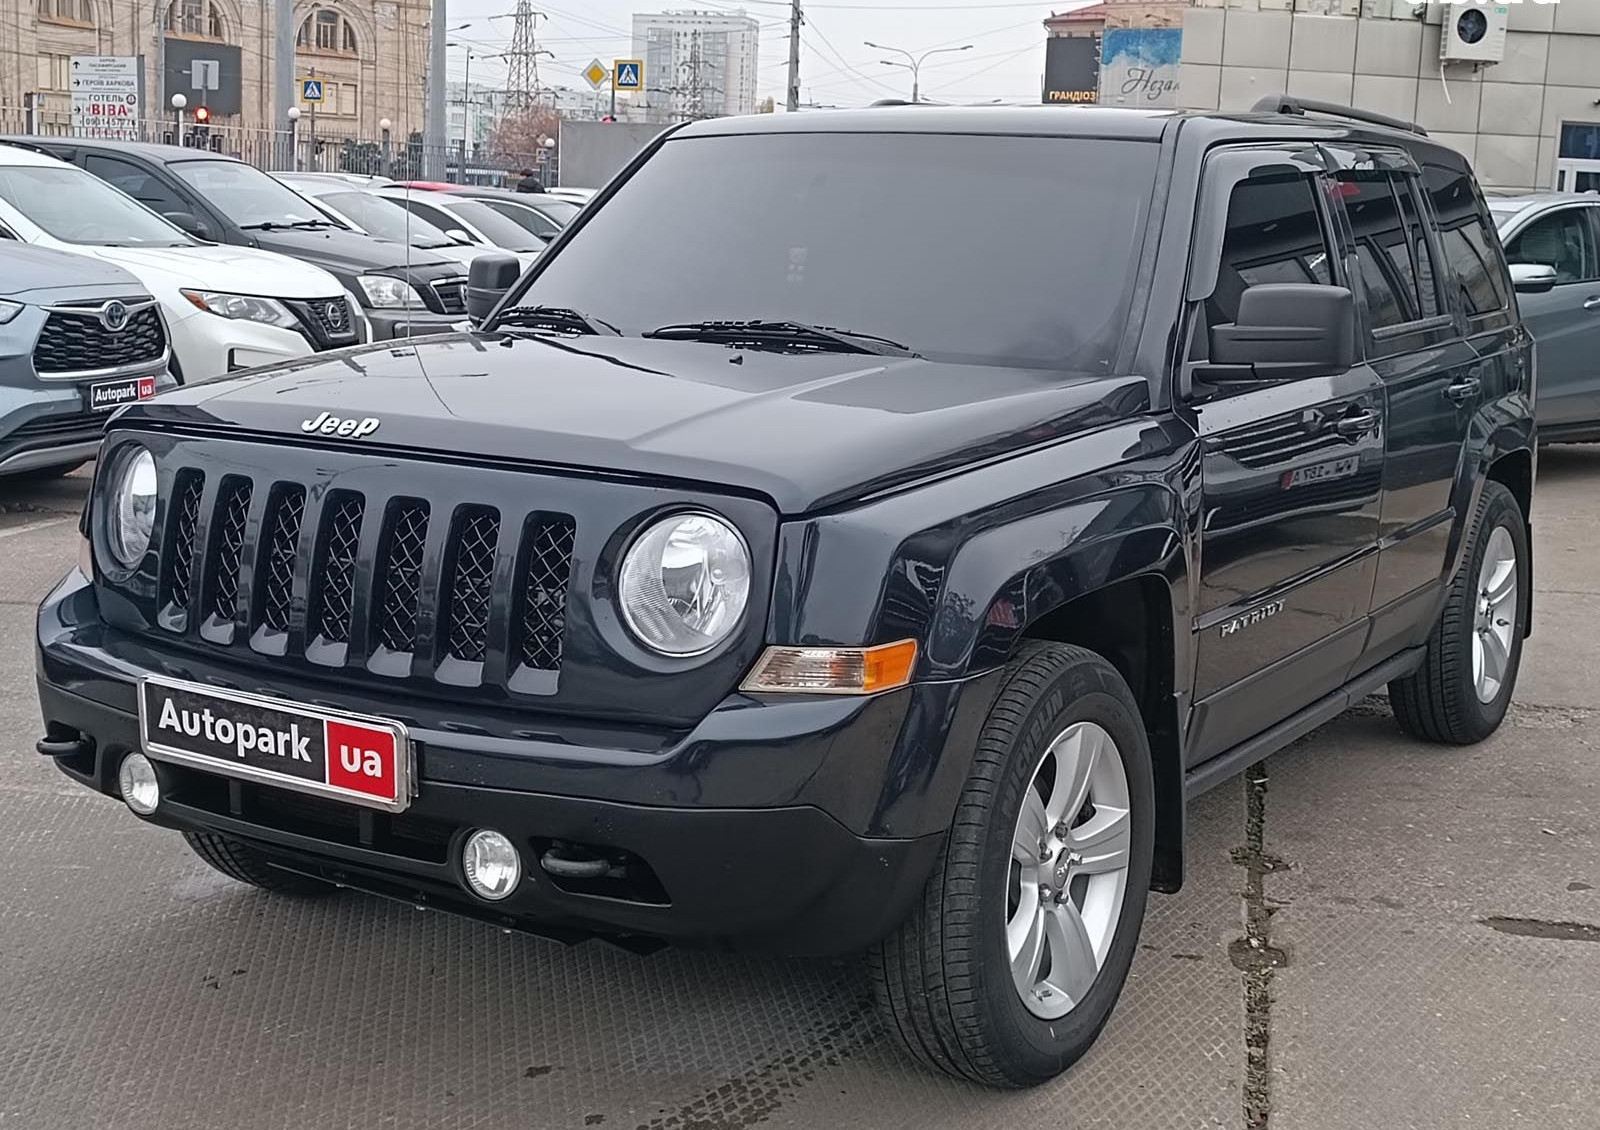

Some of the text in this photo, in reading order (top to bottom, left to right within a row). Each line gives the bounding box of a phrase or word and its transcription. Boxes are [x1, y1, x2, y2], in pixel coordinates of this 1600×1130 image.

[88, 94, 124, 102] ГОТЕЛЬ
[95, 383, 152, 402] Autopark ua
[301, 411, 380, 438] Jeep
[1220, 598, 1286, 638] PATRIOT
[158, 698, 383, 779] Autopark ua
